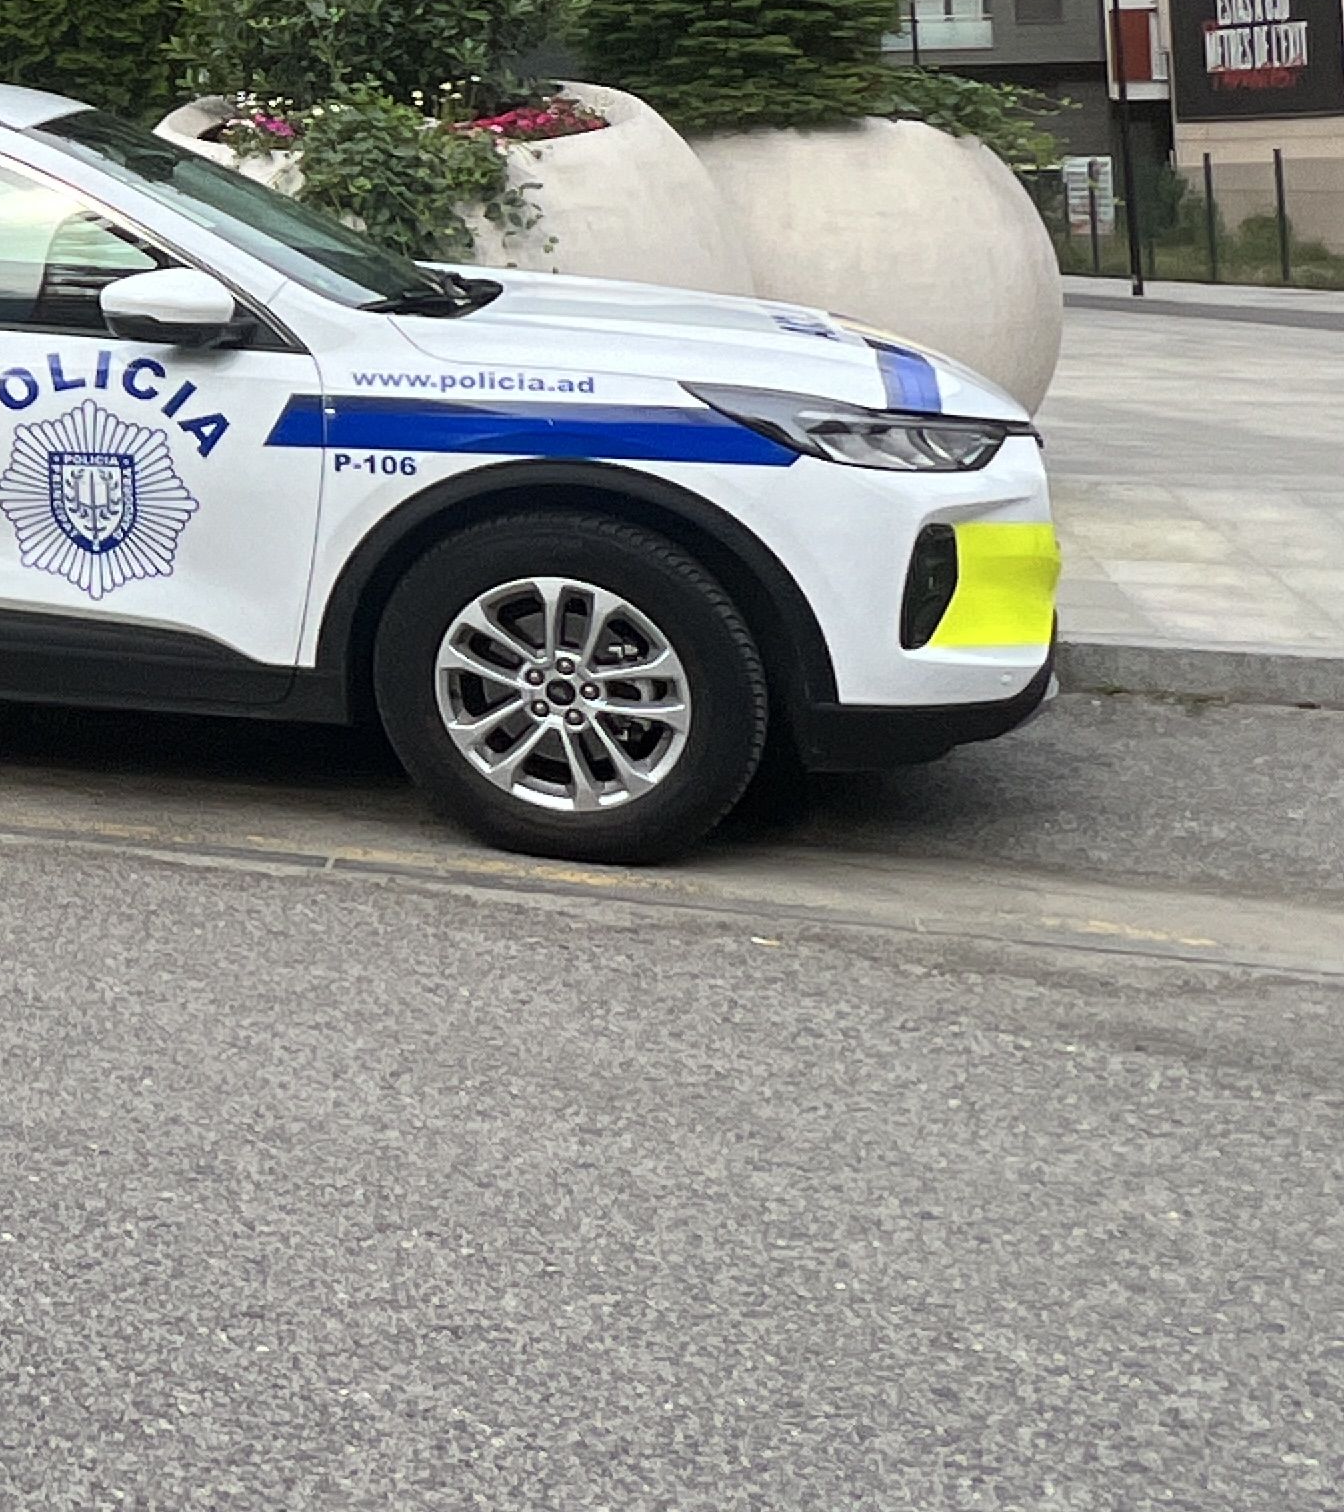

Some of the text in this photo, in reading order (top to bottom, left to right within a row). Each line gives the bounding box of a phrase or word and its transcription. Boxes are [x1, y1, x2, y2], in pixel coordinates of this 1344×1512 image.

[352, 372, 595, 394] www.policia.ad
[64, 453, 120, 466] POLICIA
[334, 453, 417, 476] P-106
